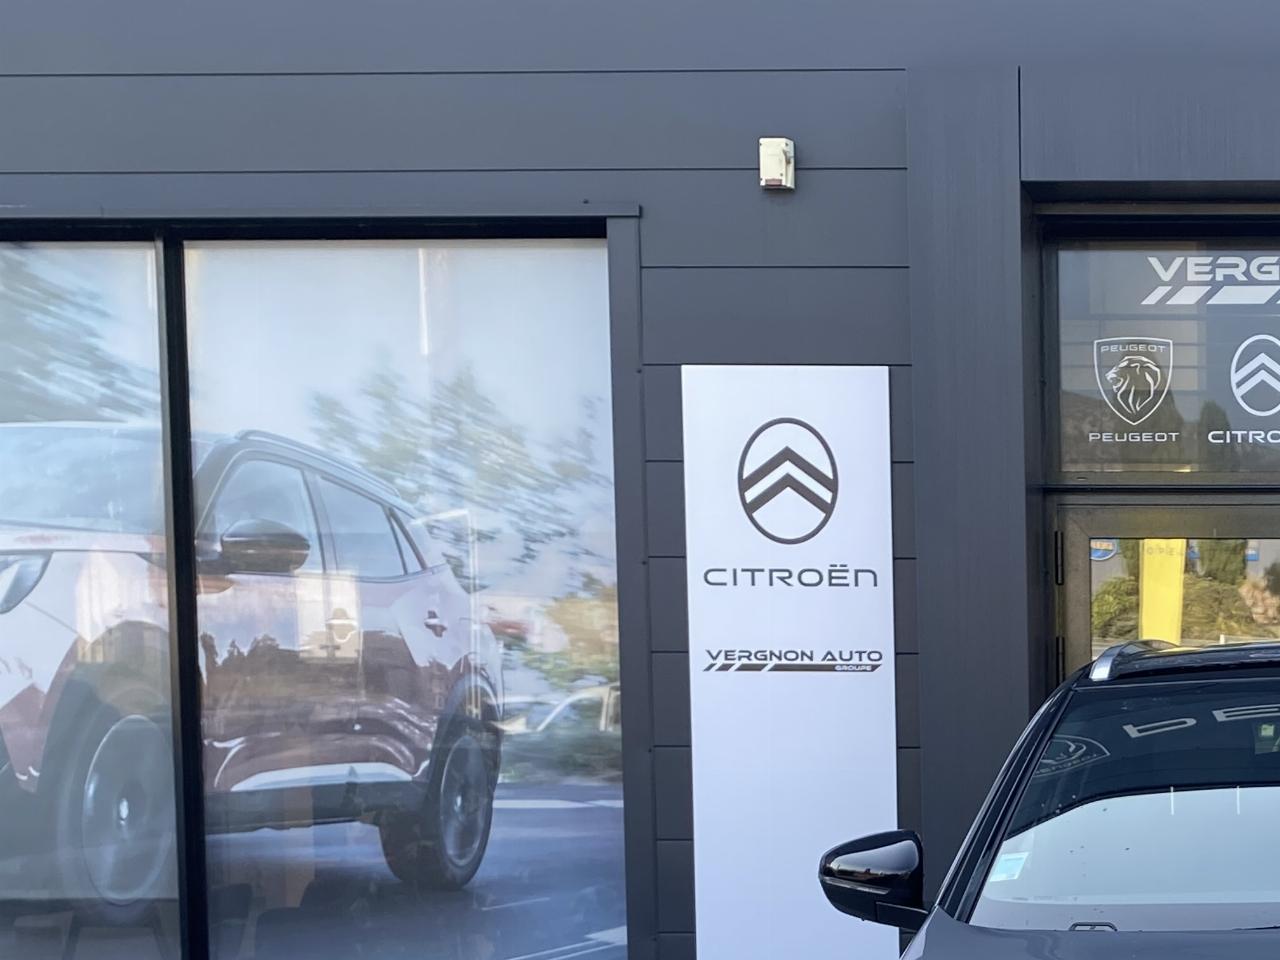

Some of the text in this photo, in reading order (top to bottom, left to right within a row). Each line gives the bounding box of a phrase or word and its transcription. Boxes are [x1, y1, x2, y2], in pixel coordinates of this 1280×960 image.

[1101, 344, 1166, 353] PEUGEOT
[1088, 432, 1180, 442] PEUGEOT
[703, 564, 878, 587] CITROËN
[705, 650, 883, 661] VERGNON AUTO
